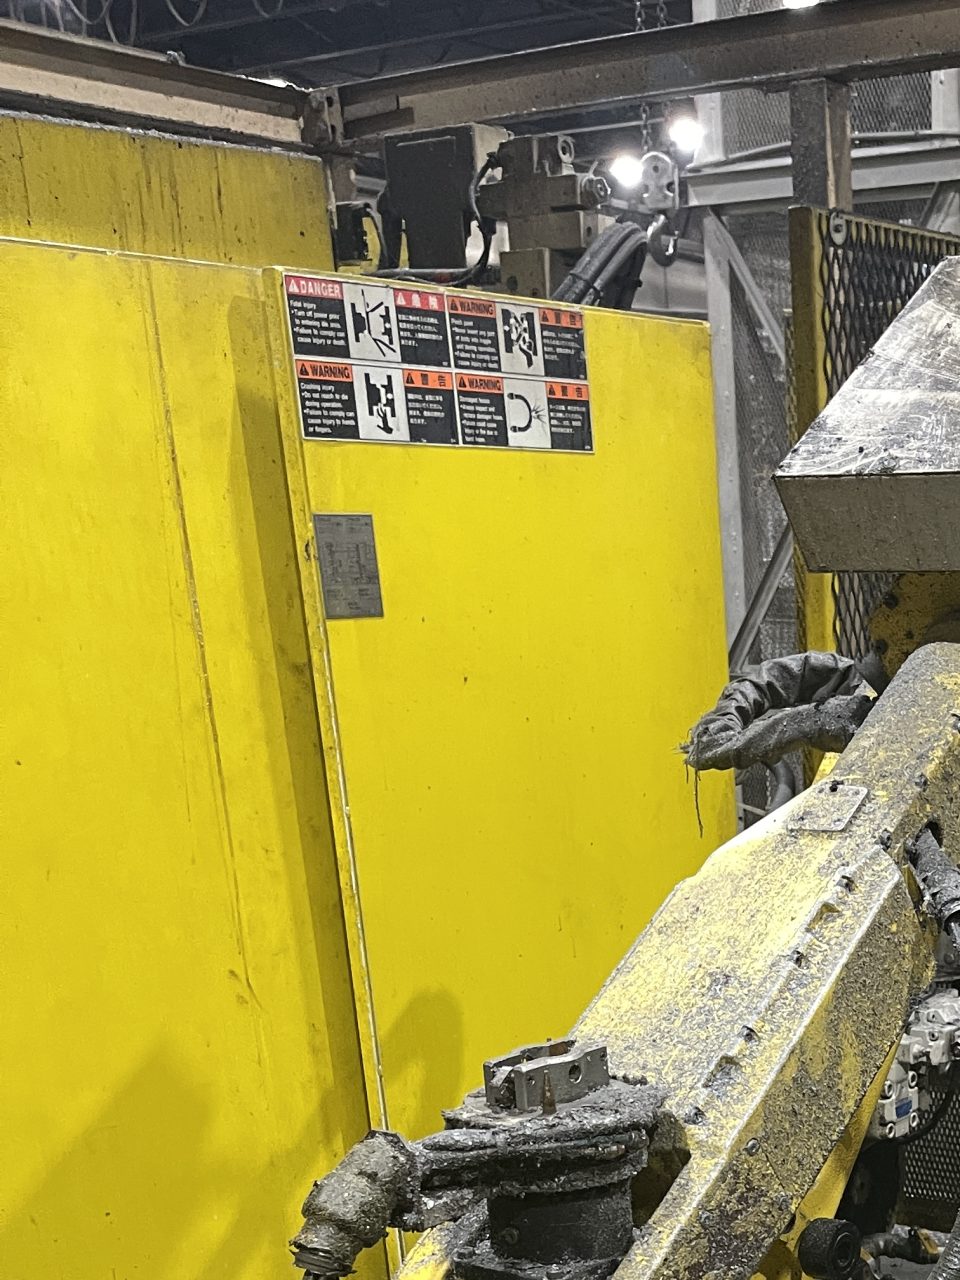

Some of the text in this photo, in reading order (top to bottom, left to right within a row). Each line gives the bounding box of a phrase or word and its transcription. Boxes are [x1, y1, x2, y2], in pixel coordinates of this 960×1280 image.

[300, 279, 342, 298] DANGER
[460, 302, 493, 315] WARNING
[310, 366, 350, 378] WARNING
[468, 379, 501, 391] WARNING
